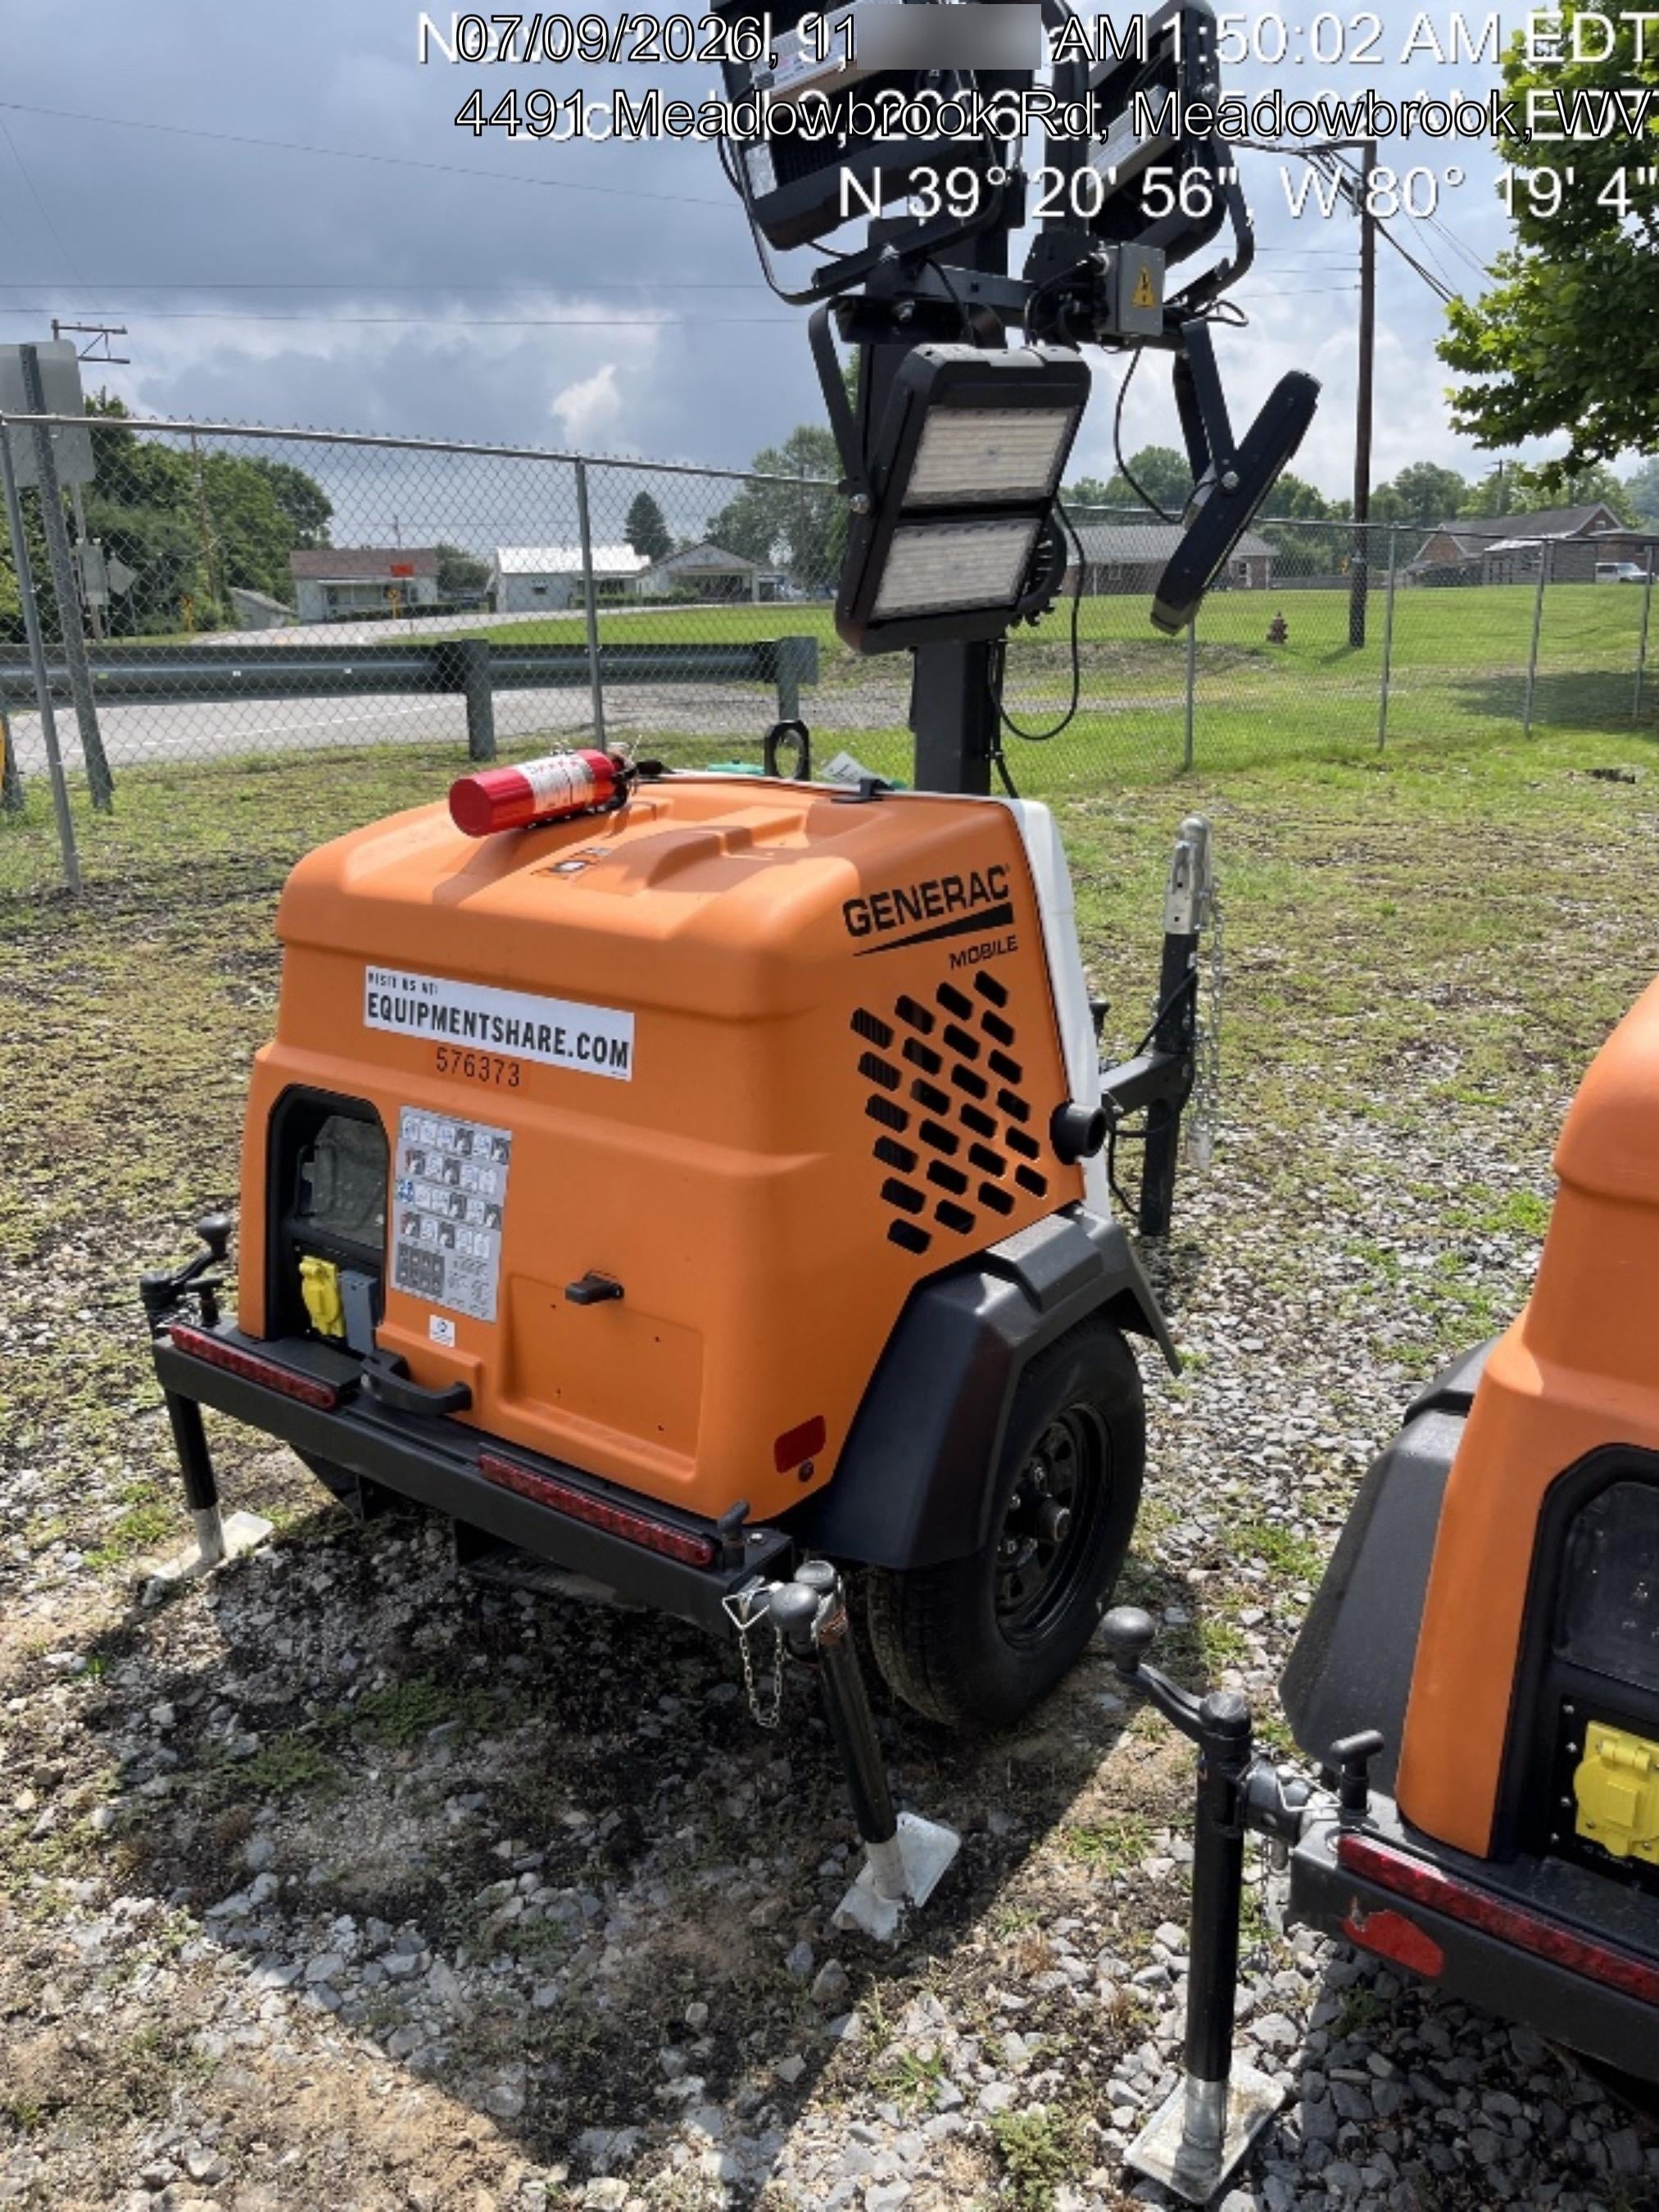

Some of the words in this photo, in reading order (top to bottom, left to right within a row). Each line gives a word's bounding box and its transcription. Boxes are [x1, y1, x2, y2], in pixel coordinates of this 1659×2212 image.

[842, 864, 1009, 937] GENERAC
[949, 934, 1019, 969] MOBILE
[368, 992, 629, 1069] EQUIPMENTSHARE.COM
[436, 1046, 520, 1087] 576373
